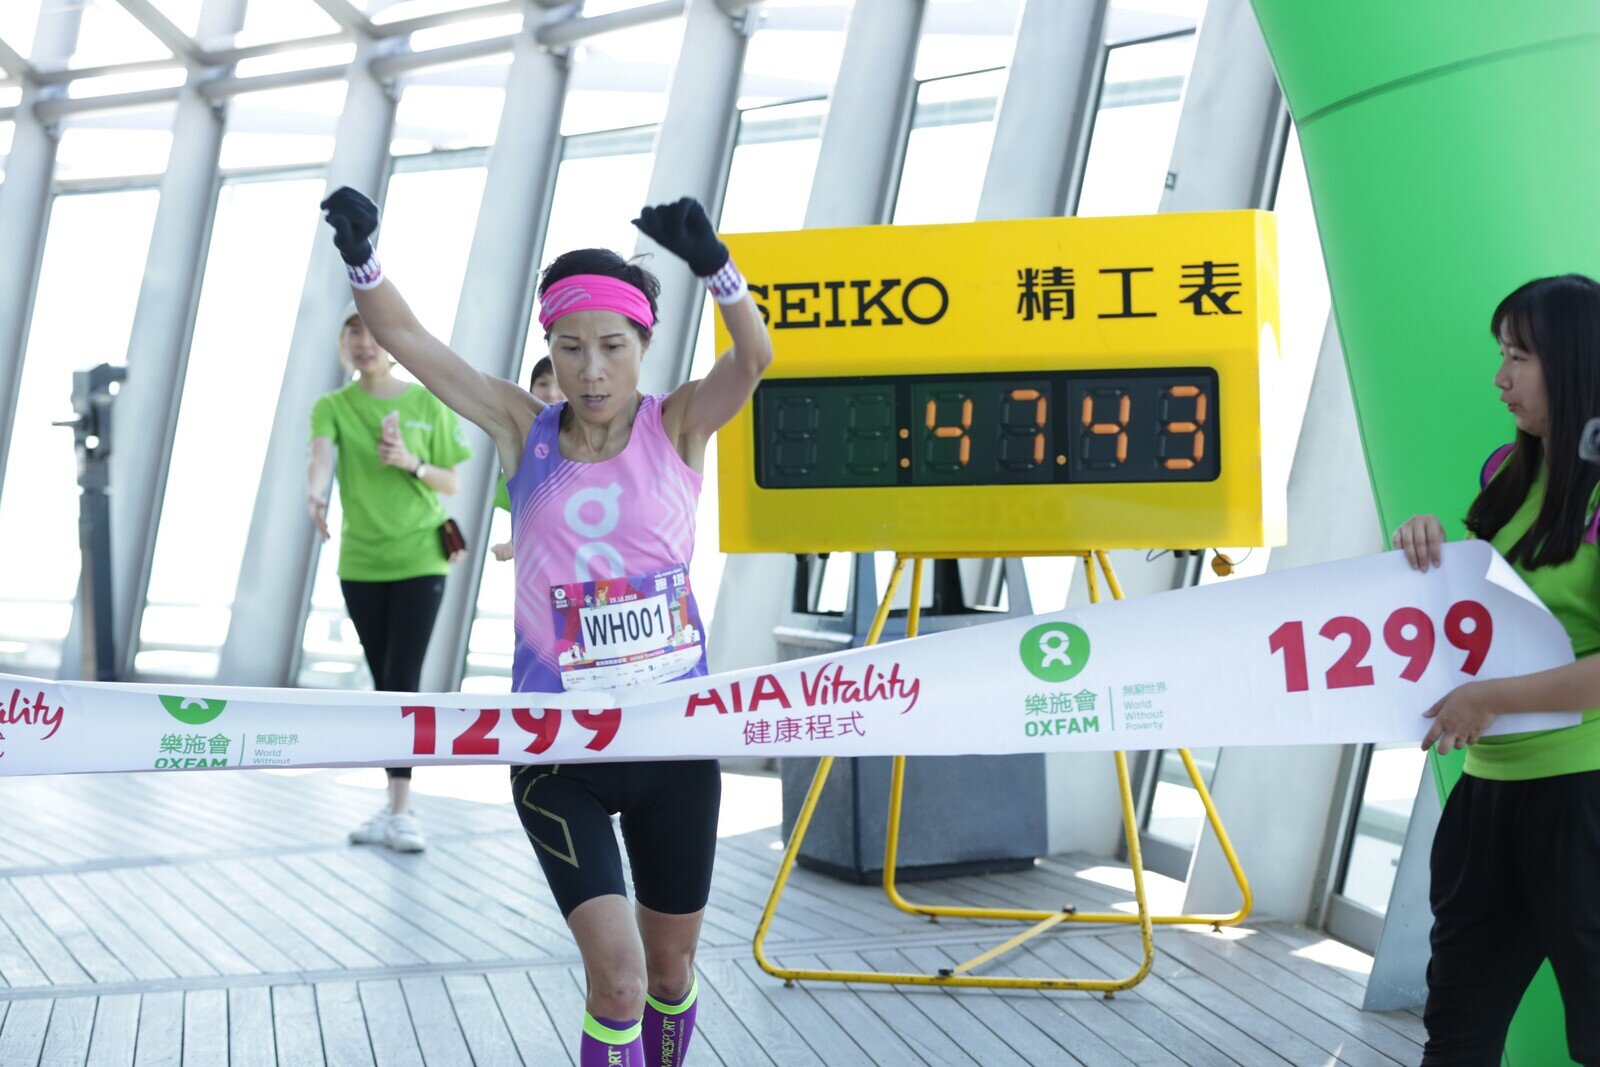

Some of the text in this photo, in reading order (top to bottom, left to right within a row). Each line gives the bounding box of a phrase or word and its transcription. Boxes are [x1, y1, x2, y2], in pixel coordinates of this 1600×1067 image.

[1016, 260, 1243, 322] 精工表
[584, 603, 665, 647] WH001
[1268, 600, 1493, 693] 1299
[684, 674, 792, 717] AIA
[800, 662, 920, 715] Vitality
[1025, 688, 1098, 716] 樂施會
[1123, 700, 1152, 710] World
[1125, 710, 1164, 721] Without
[400, 706, 622, 755] 1299
[742, 711, 866, 745] 健康程式
[1024, 715, 1100, 737] OXFAM
[1125, 721, 1163, 731] Poverty
[159, 733, 232, 754] 樂施會
[254, 749, 282, 757] World
[154, 757, 228, 769] OXFAM
